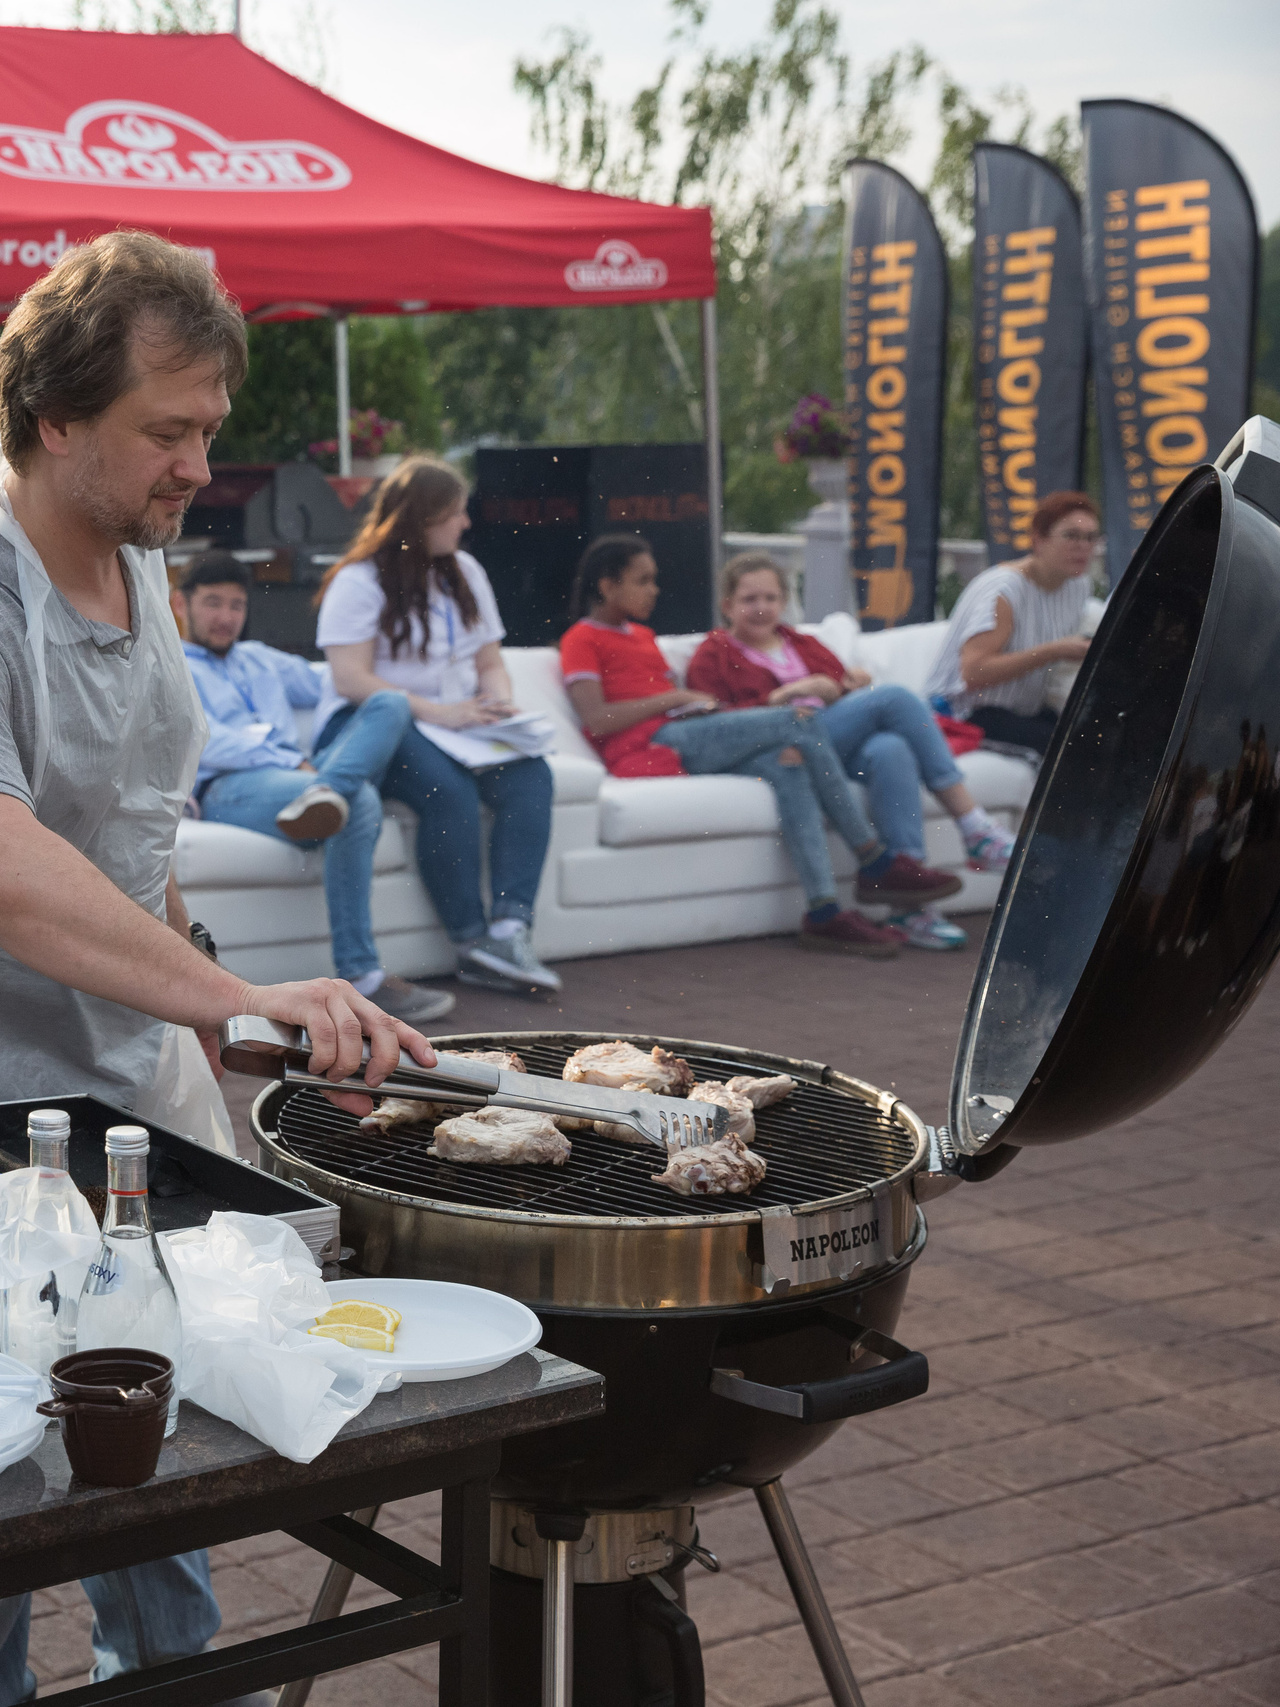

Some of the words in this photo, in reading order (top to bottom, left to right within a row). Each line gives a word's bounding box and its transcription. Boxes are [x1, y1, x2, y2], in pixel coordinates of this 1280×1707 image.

[13, 135, 312, 184] NAPOLEON
[790, 1219, 880, 1262] NAPOLEON
[88, 1263, 117, 1285] soxy
